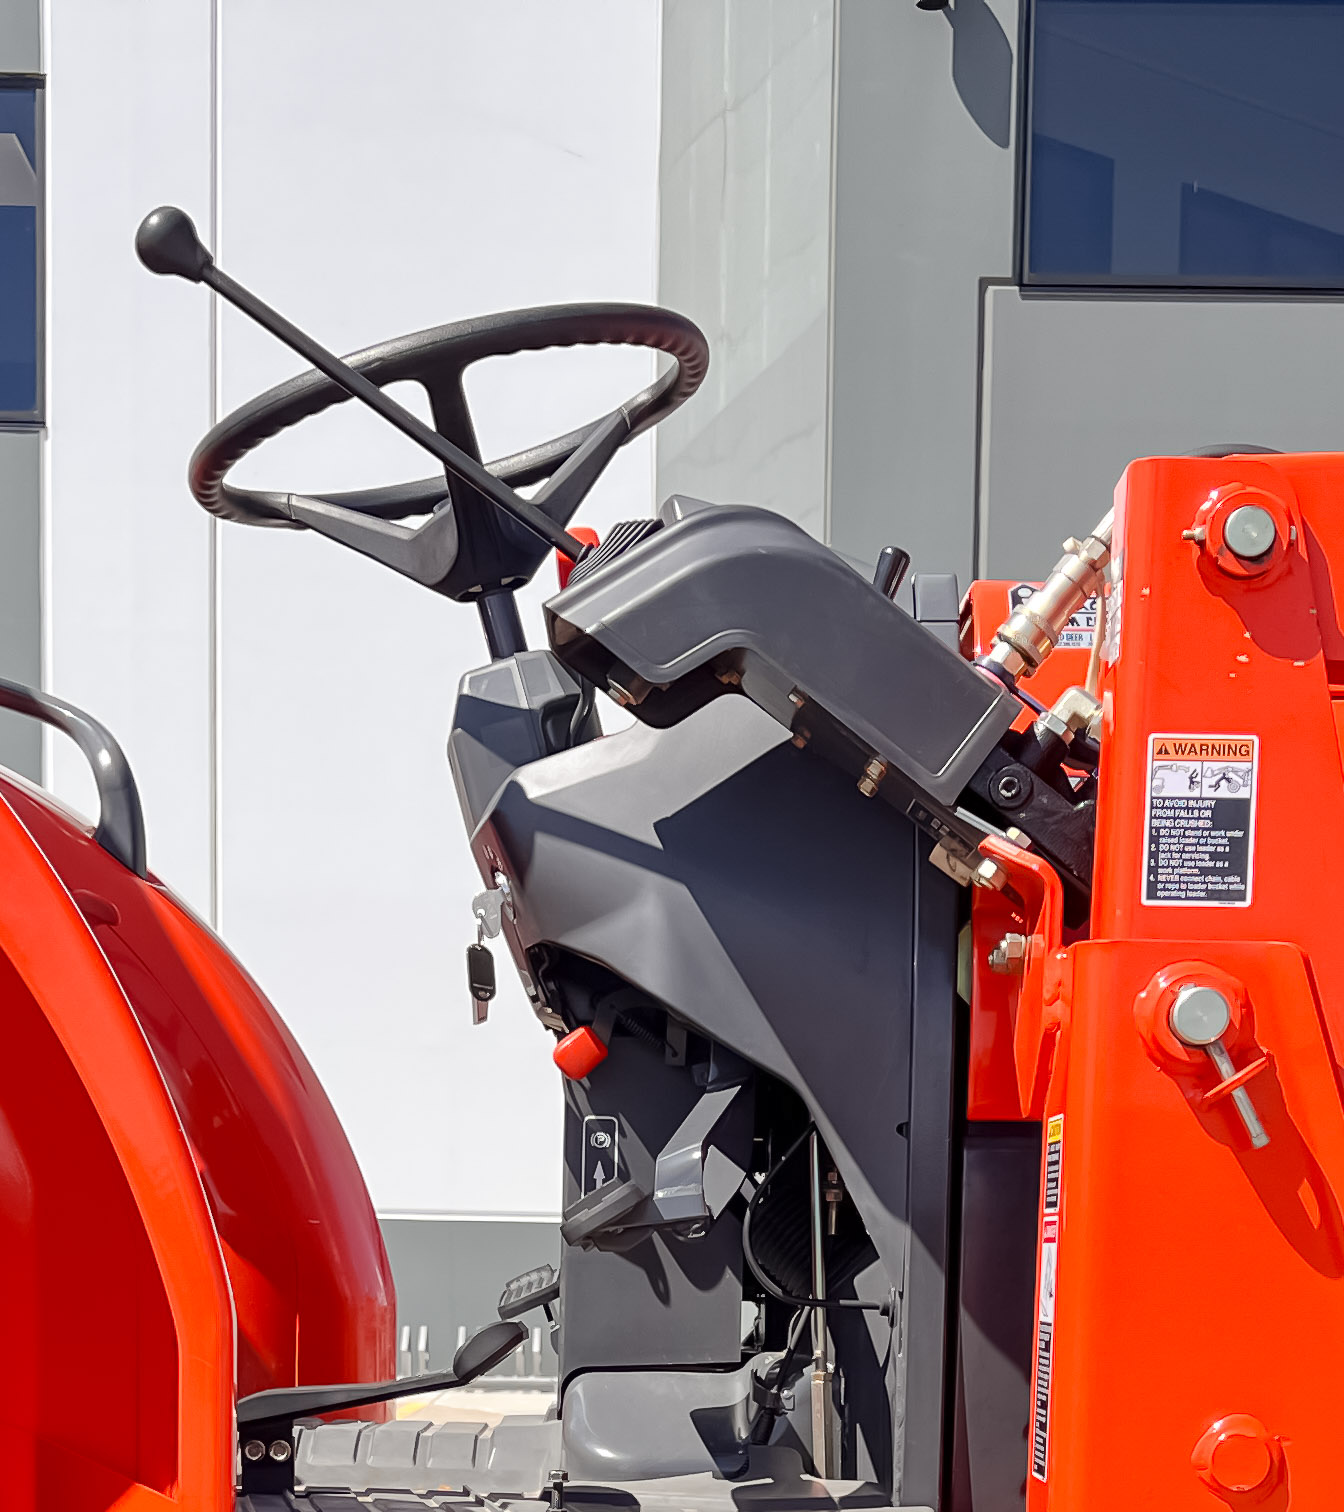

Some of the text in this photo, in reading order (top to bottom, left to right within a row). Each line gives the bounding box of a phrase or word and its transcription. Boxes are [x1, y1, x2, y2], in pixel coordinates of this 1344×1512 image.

[1172, 742, 1251, 757] WARNING
[1151, 799, 1216, 808] TO AVOID INJURY
[1151, 809, 1212, 818] FROM FALLS OR
[1151, 819, 1174, 827] BEING
[1170, 844, 1184, 852] NOT
[1158, 859, 1169, 867] DO
[1169, 859, 1183, 867] NOT
